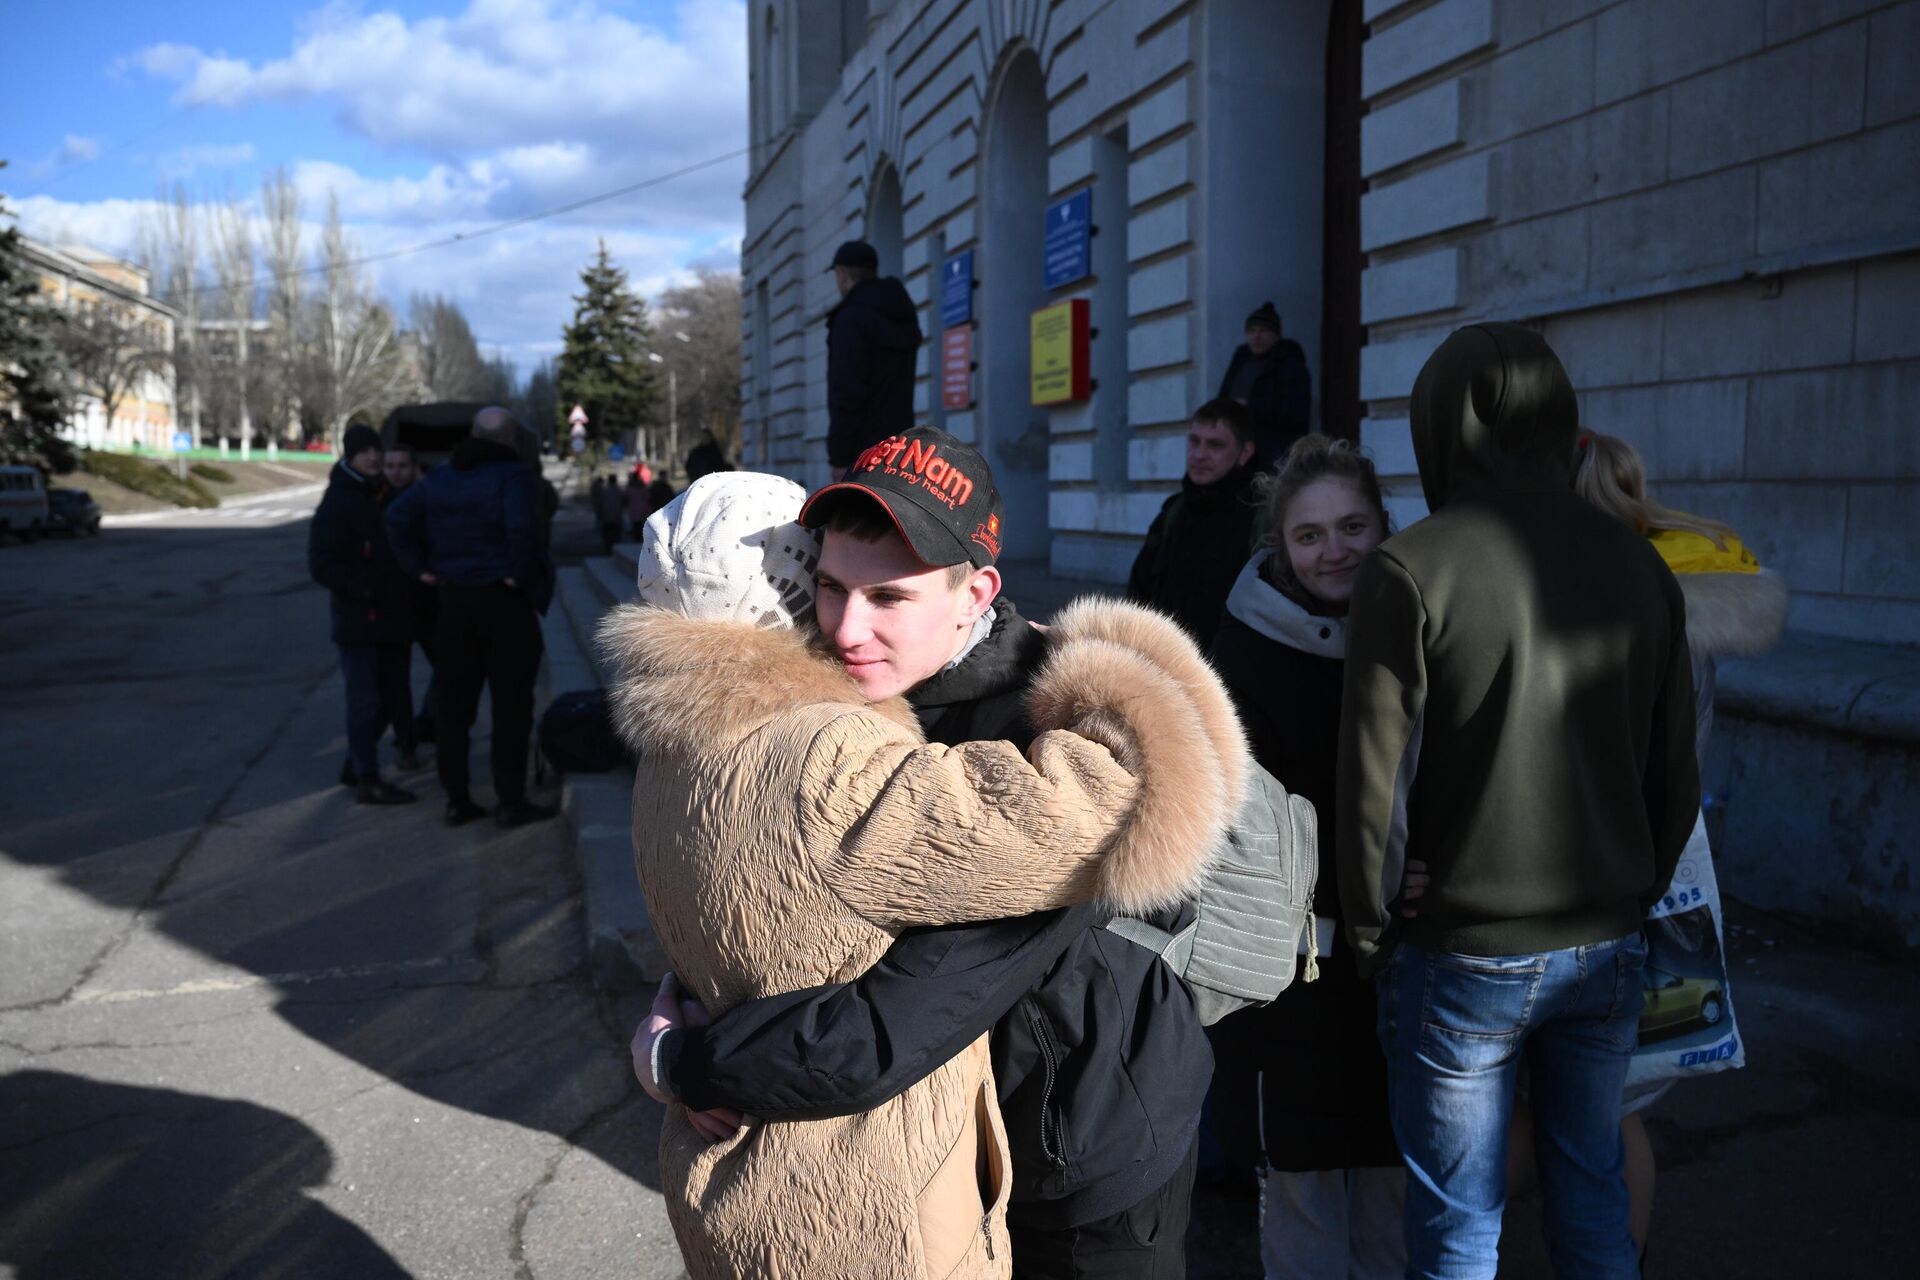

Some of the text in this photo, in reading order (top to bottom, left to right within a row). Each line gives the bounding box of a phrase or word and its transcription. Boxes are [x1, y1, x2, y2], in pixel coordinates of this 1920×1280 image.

[884, 465, 956, 511] in my heart
[900, 438, 974, 506] Nam
[1682, 1038, 1737, 1066] FIA
